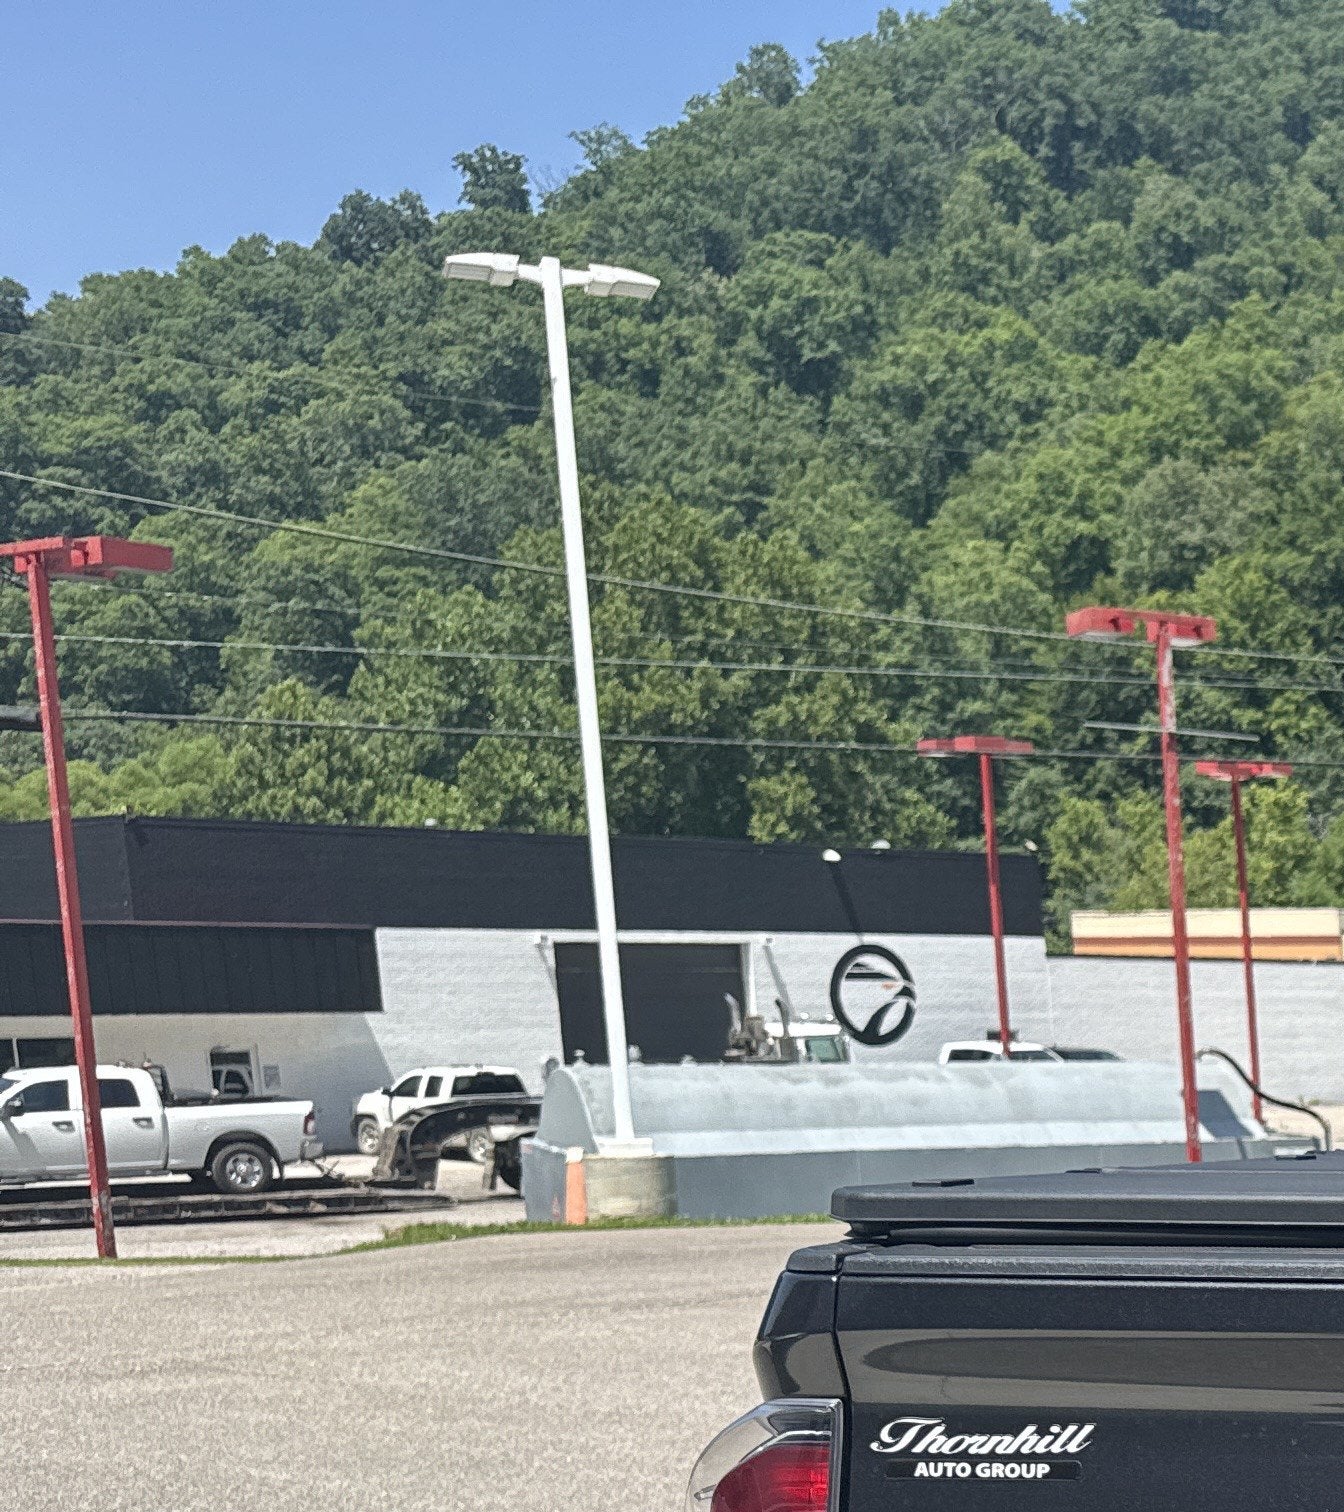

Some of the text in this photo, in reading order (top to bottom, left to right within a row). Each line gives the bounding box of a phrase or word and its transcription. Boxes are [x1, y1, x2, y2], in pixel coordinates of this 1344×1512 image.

[869, 1416, 1097, 1455] Thornhill
[913, 1461, 1051, 1479] AUTO GROUP
